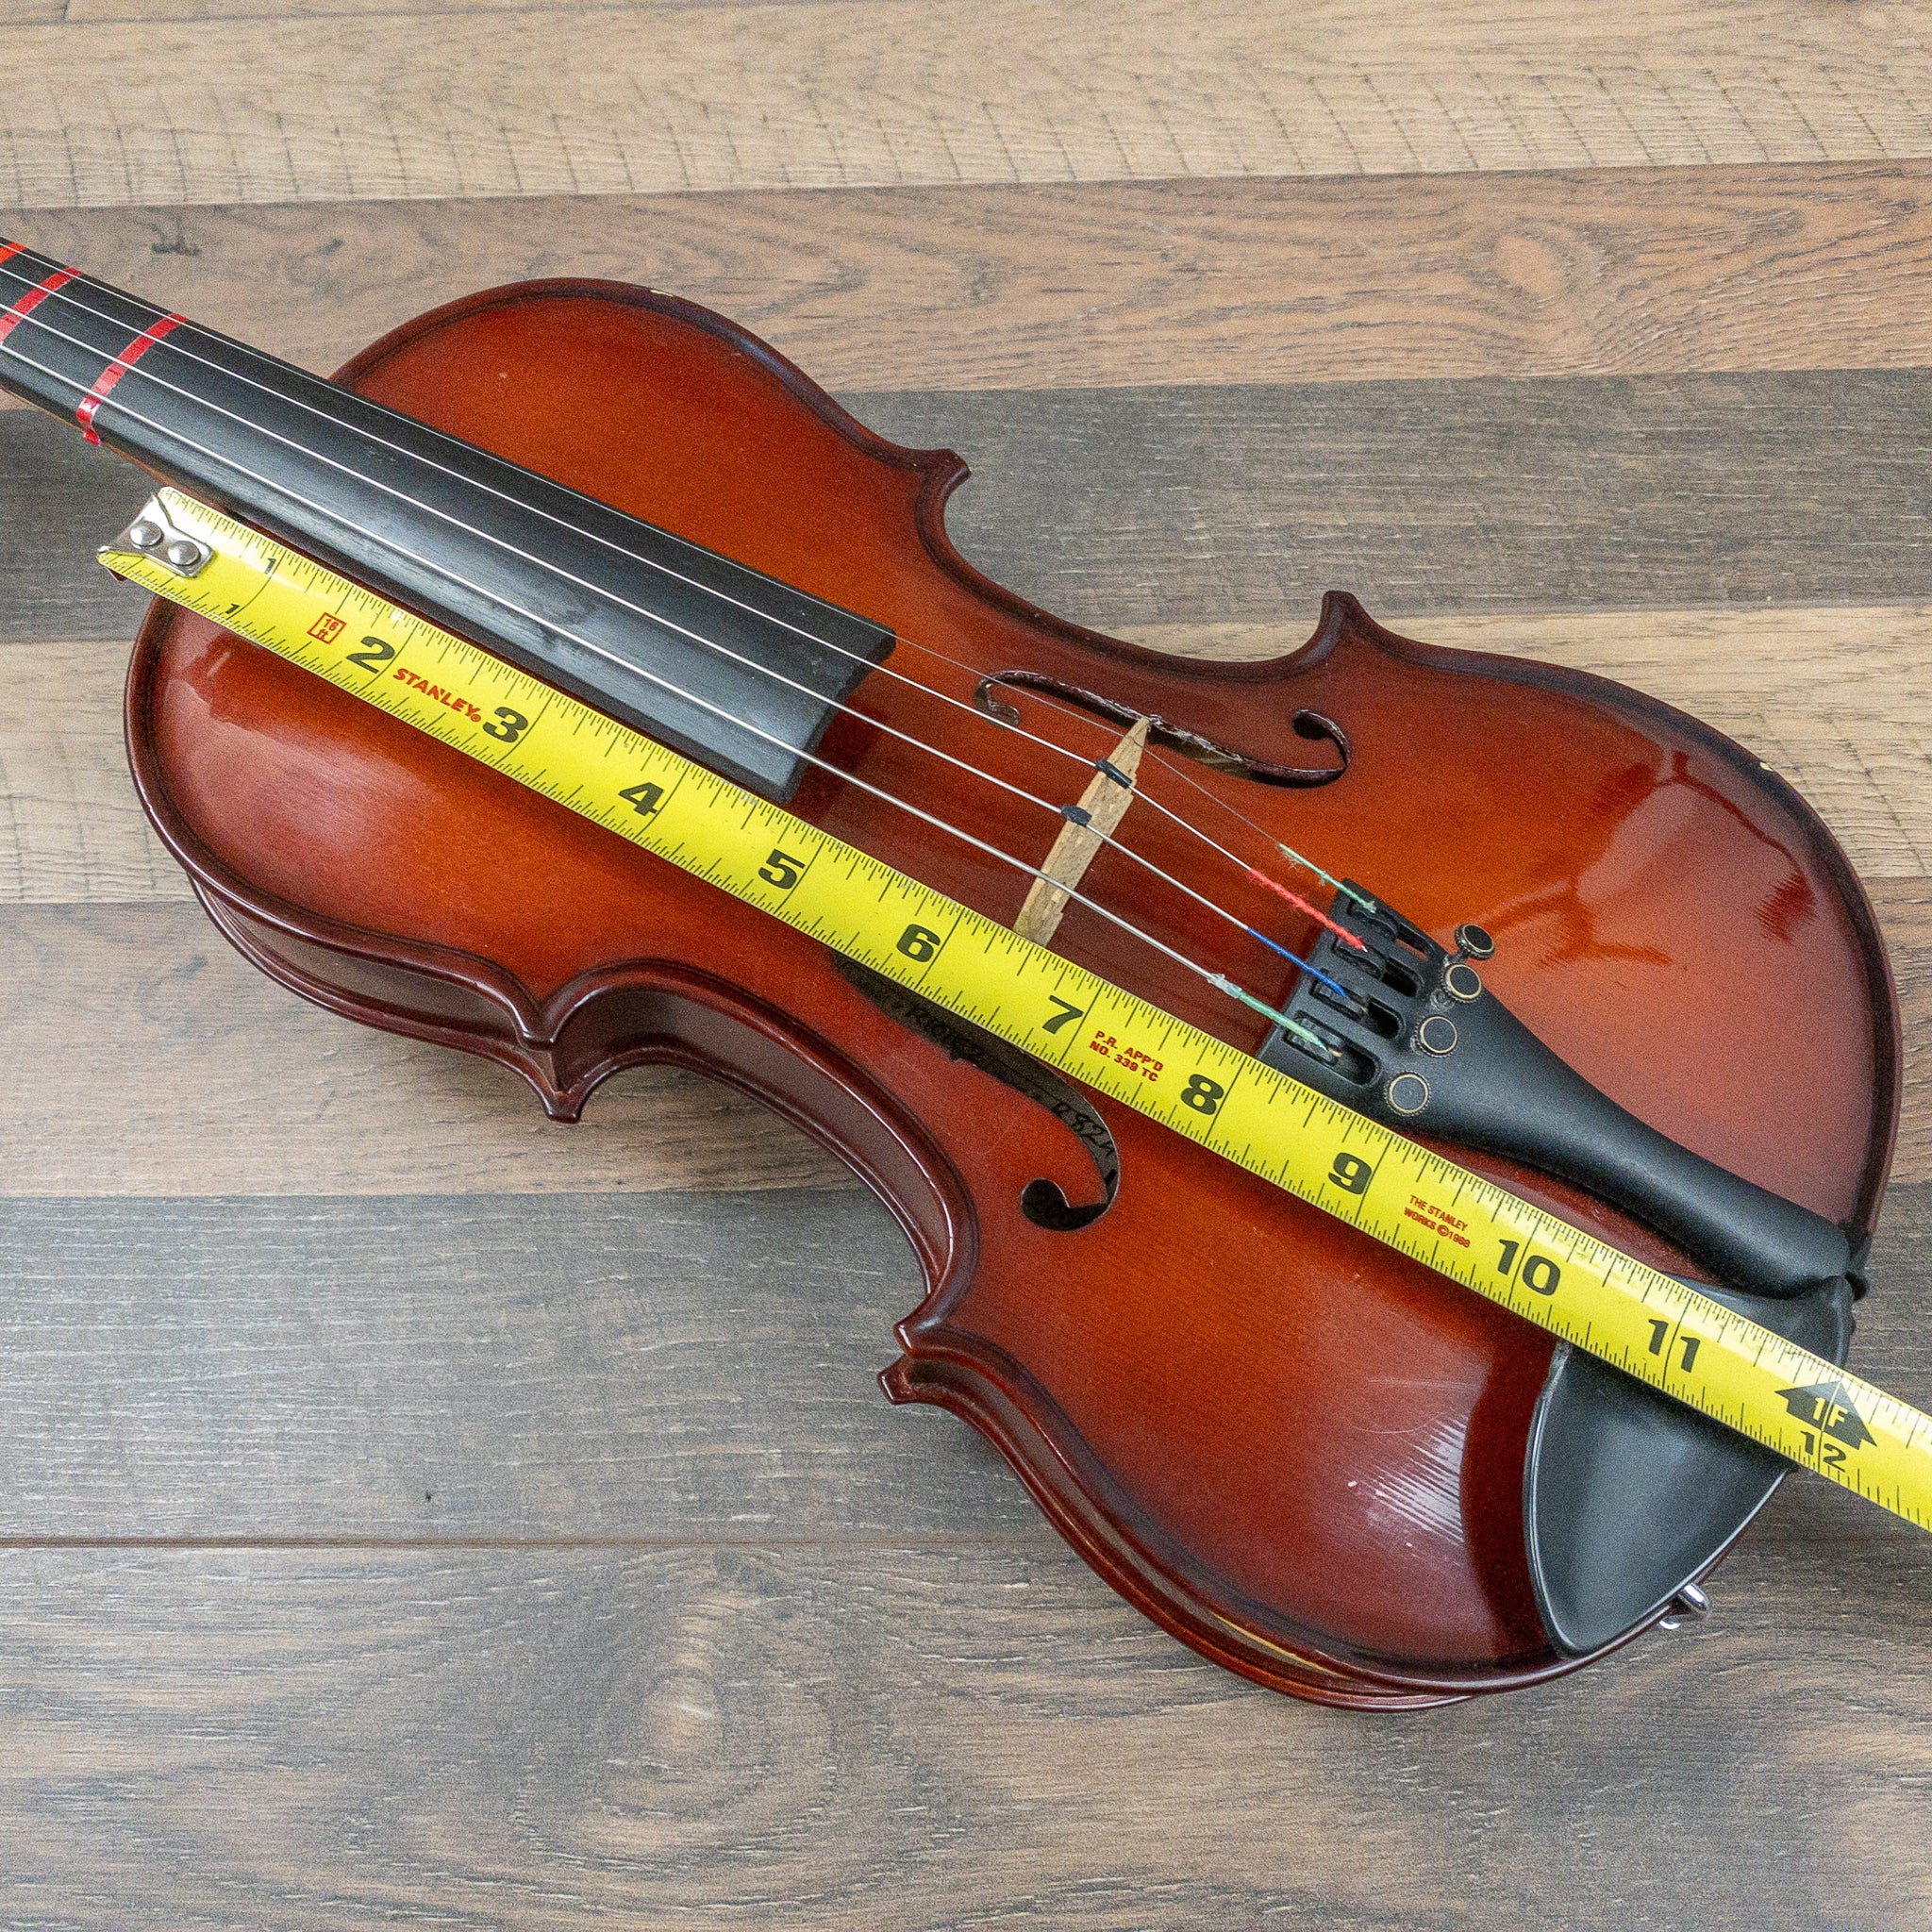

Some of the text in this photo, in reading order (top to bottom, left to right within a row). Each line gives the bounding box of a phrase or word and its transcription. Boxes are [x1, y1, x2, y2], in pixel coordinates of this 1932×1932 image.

[264, 558, 277, 575] 1
[225, 603, 241, 614] 1
[325, 618, 339, 630] 16
[316, 629, 329, 641] ft
[345, 636, 396, 675] 2
[482, 707, 528, 743] 3
[618, 782, 665, 817] 4
[758, 848, 806, 891] 5
[895, 924, 941, 964] 6
[1041, 995, 1084, 1035] 7
[1089, 1041, 1110, 1058] NO.
[1141, 1067, 1159, 1082] TC
[1094, 1030, 1164, 1072] P.R. APP'D
[1180, 1074, 1225, 1116] 8
[1327, 1152, 1373, 1195] 9
[1404, 1207, 1437, 1230] WORKS
[1409, 1194, 1468, 1232] THE STANLEY
[1497, 1239, 1561, 1297] 10
[1647, 1318, 1701, 1374] 11
[1812, 1397, 1849, 1428] 1F
[1800, 1430, 1847, 1473] 12
